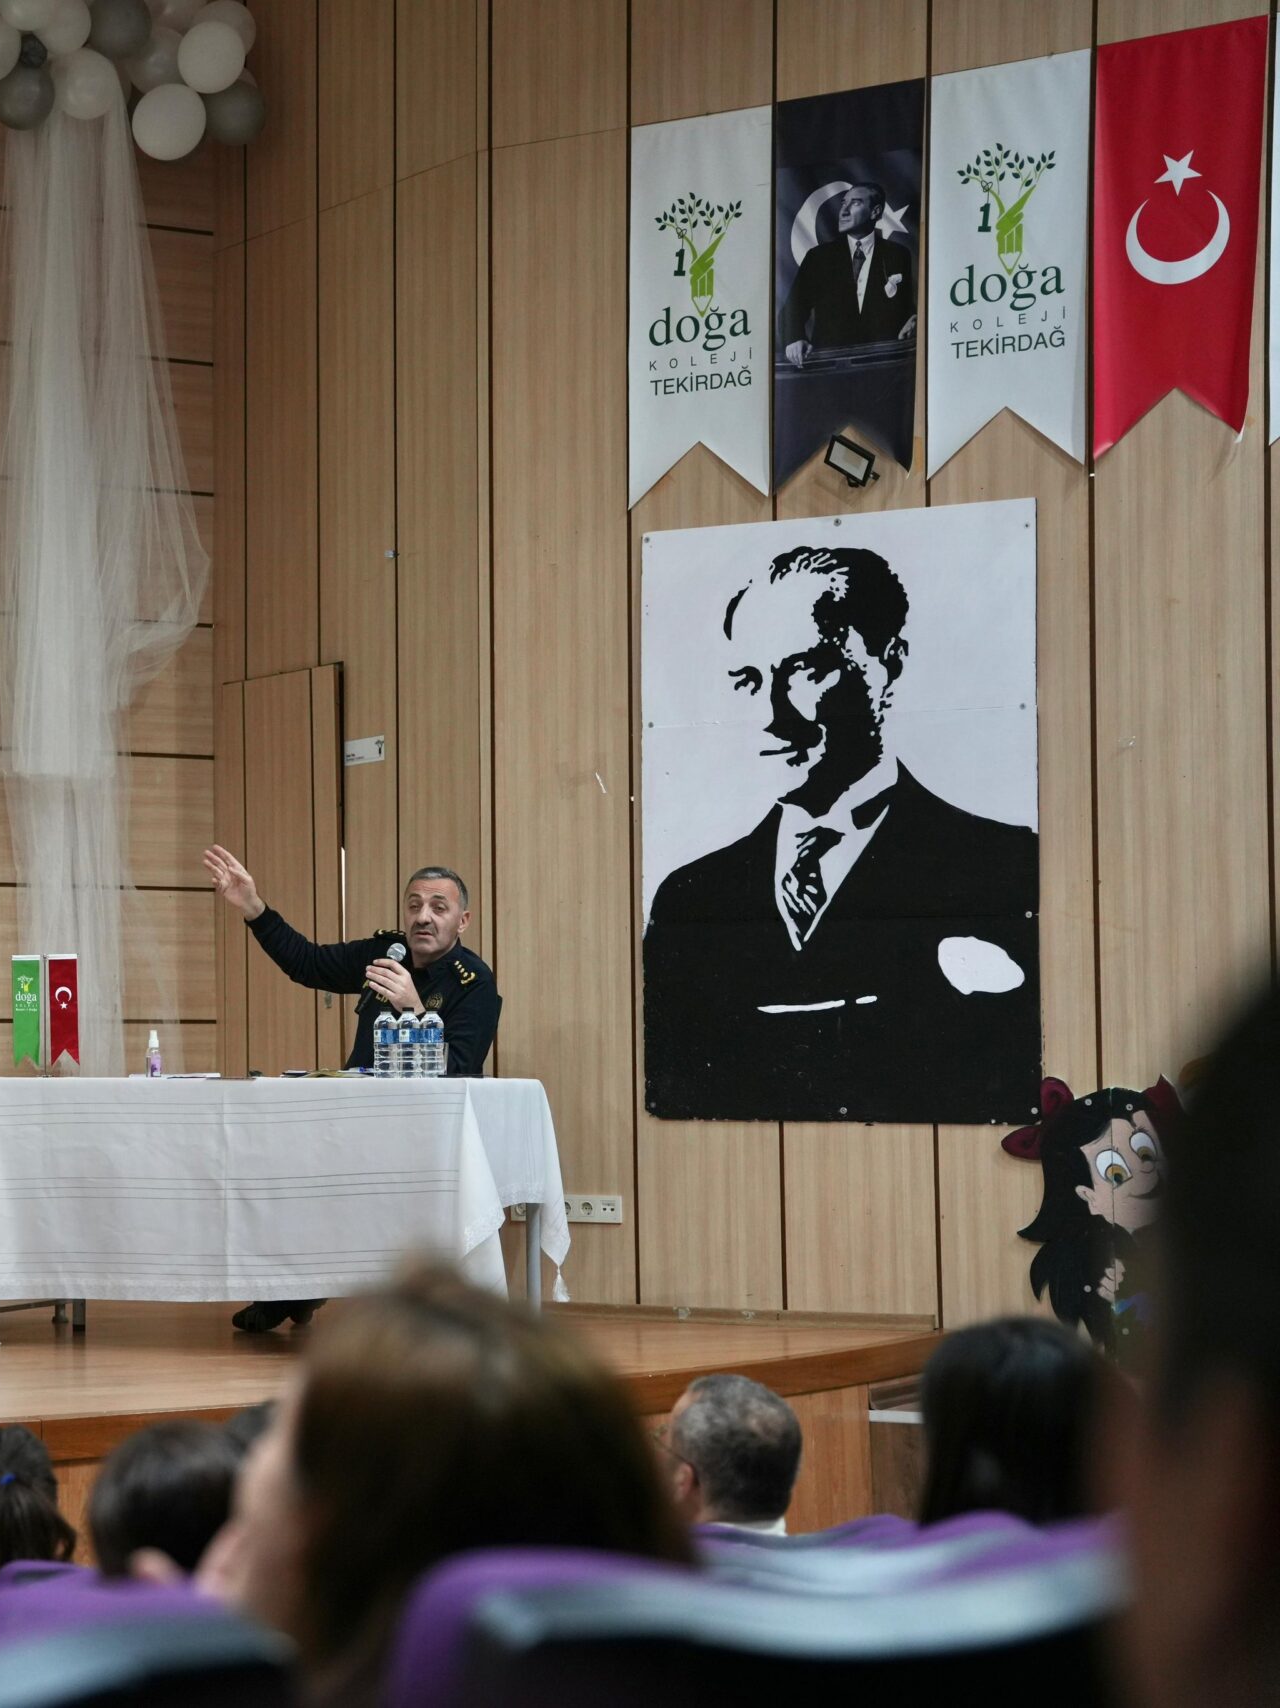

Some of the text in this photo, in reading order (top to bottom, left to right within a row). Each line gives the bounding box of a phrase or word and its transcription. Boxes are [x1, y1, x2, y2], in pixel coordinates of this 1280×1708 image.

[950, 263, 1065, 311] doğa
[649, 306, 751, 352] doğa
[950, 306, 1066, 333] KOLEJİ
[951, 325, 1065, 359] TEKİRDAĞ
[649, 347, 752, 371] KOLEJİ
[650, 365, 752, 396] TEKİRDAĞ
